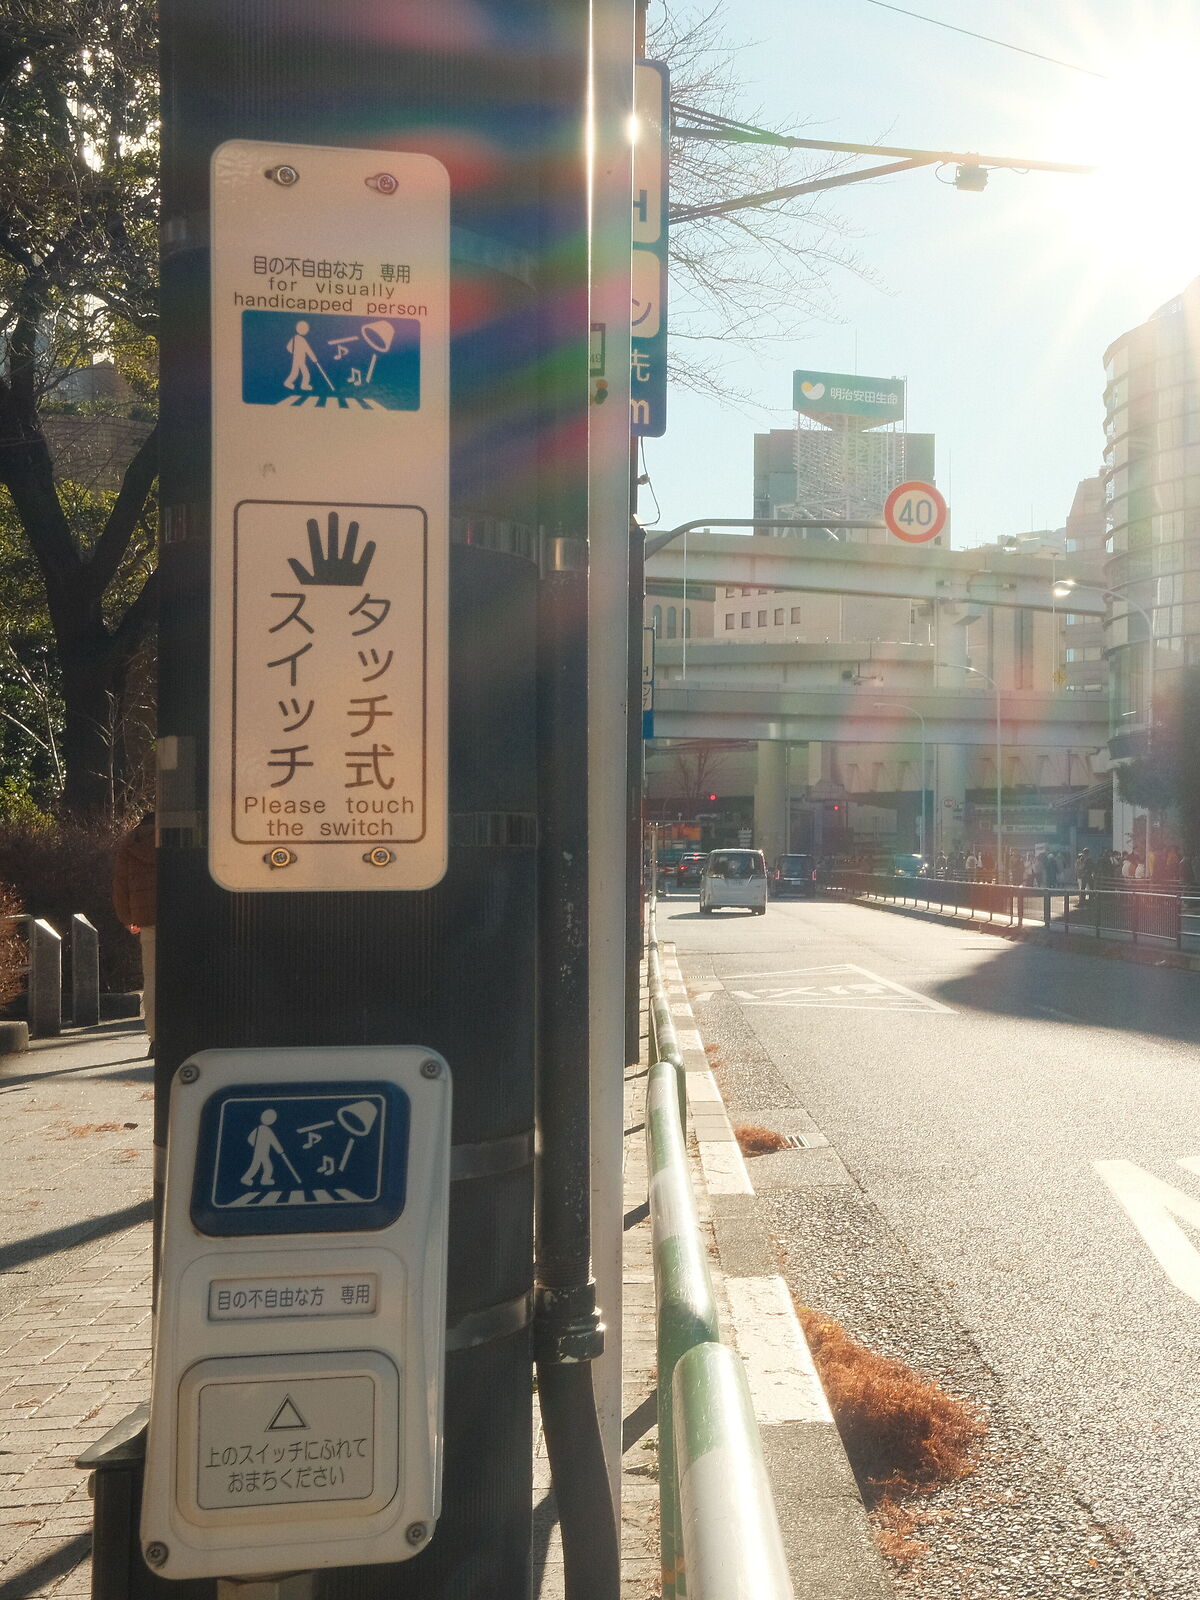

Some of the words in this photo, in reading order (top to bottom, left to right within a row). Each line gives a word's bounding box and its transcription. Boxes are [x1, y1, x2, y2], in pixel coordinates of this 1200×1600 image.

[253, 255, 364, 281] 目の不自由な方
[380, 264, 411, 284] 専用
[268, 278, 298, 292] for
[316, 279, 395, 299] visually
[234, 292, 352, 313] handicapped
[366, 301, 428, 317] person
[831, 388, 897, 403] 明治安田生命
[899, 500, 932, 526] 40
[267, 592, 315, 789] スイッチ
[344, 592, 395, 790] タッチ式
[244, 796, 326, 814] Please
[346, 796, 414, 814] touch
[267, 818, 304, 836] the
[319, 818, 394, 837] switch
[218, 1285, 325, 1311] 目の不自由な方
[340, 1284, 371, 1306] 専用
[205, 1437, 367, 1470] 上のスイッチにふれて
[227, 1466, 345, 1493] おまちください
